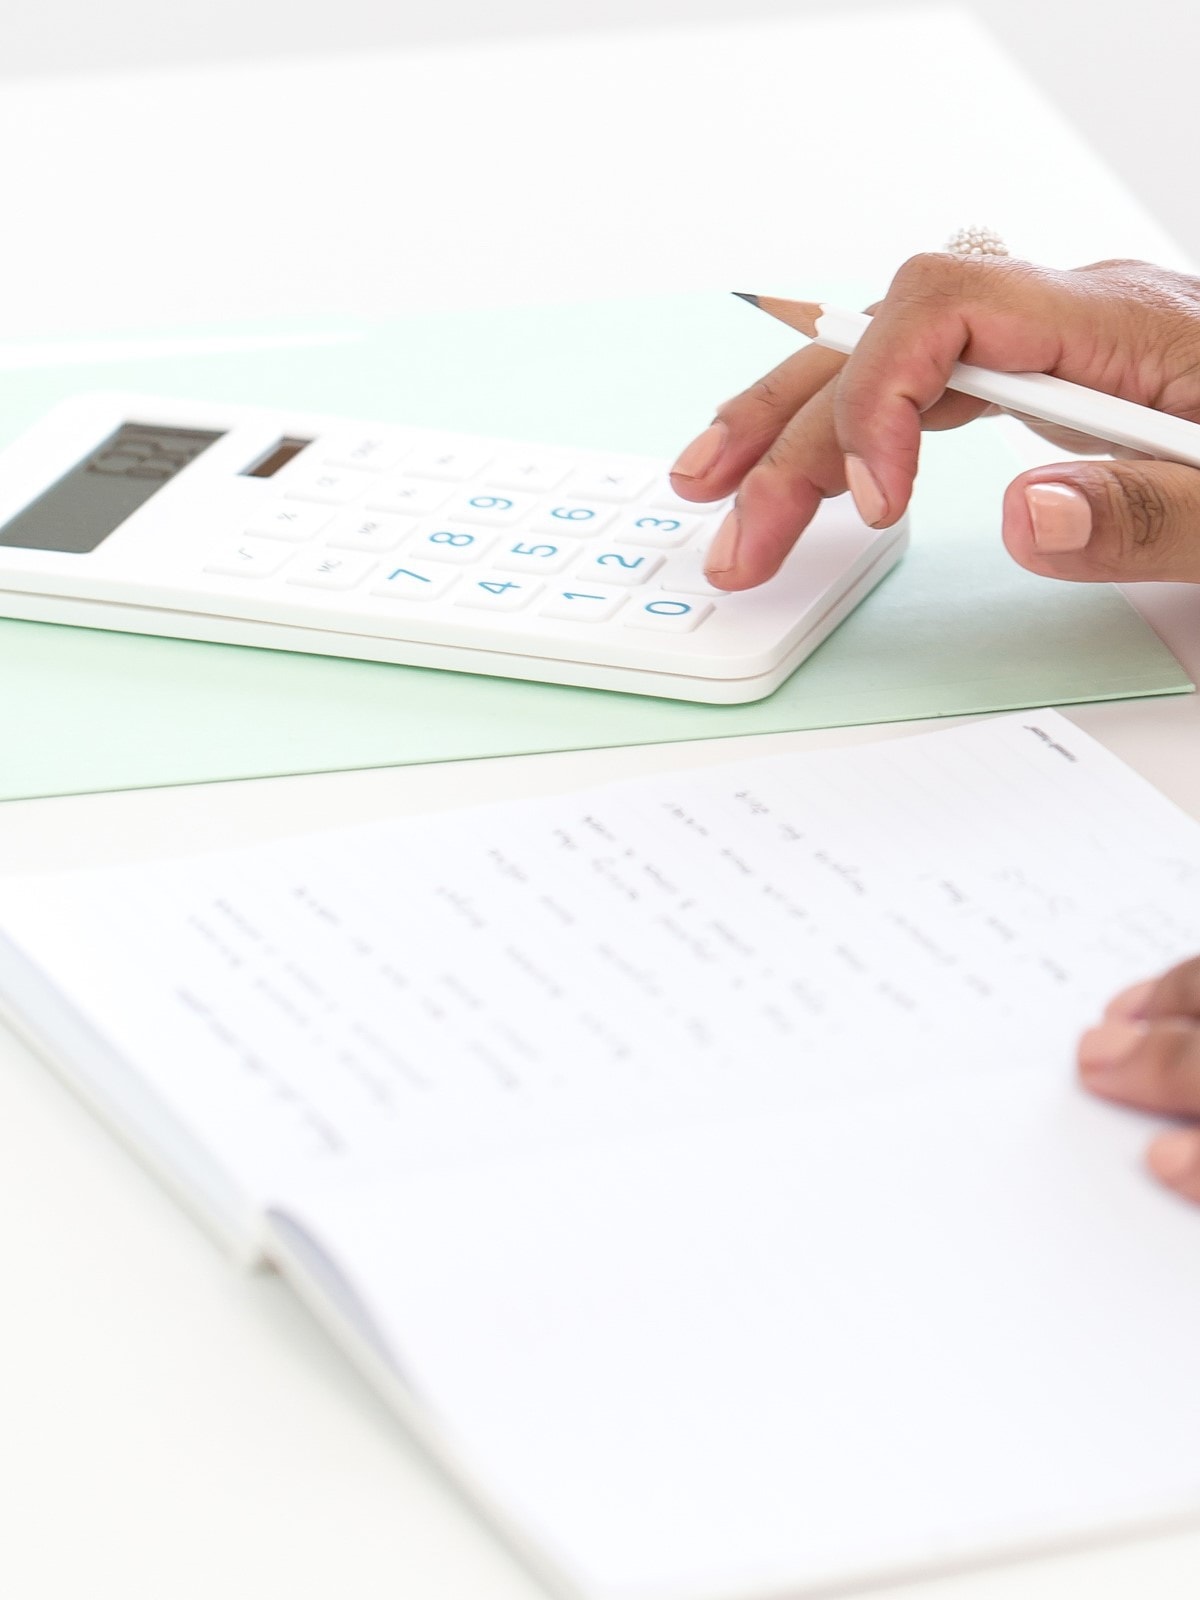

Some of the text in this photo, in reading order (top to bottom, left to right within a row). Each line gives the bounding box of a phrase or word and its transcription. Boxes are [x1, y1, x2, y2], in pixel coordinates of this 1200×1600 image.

[468, 496, 513, 510] 9
[550, 508, 595, 521] 6
[635, 517, 680, 532] 3
[428, 531, 475, 547] 8
[510, 543, 558, 557] 5
[596, 553, 645, 570] 2
[386, 568, 431, 583] 7
[477, 580, 521, 595] 4
[561, 591, 607, 601] 1
[644, 600, 691, 616] 0
